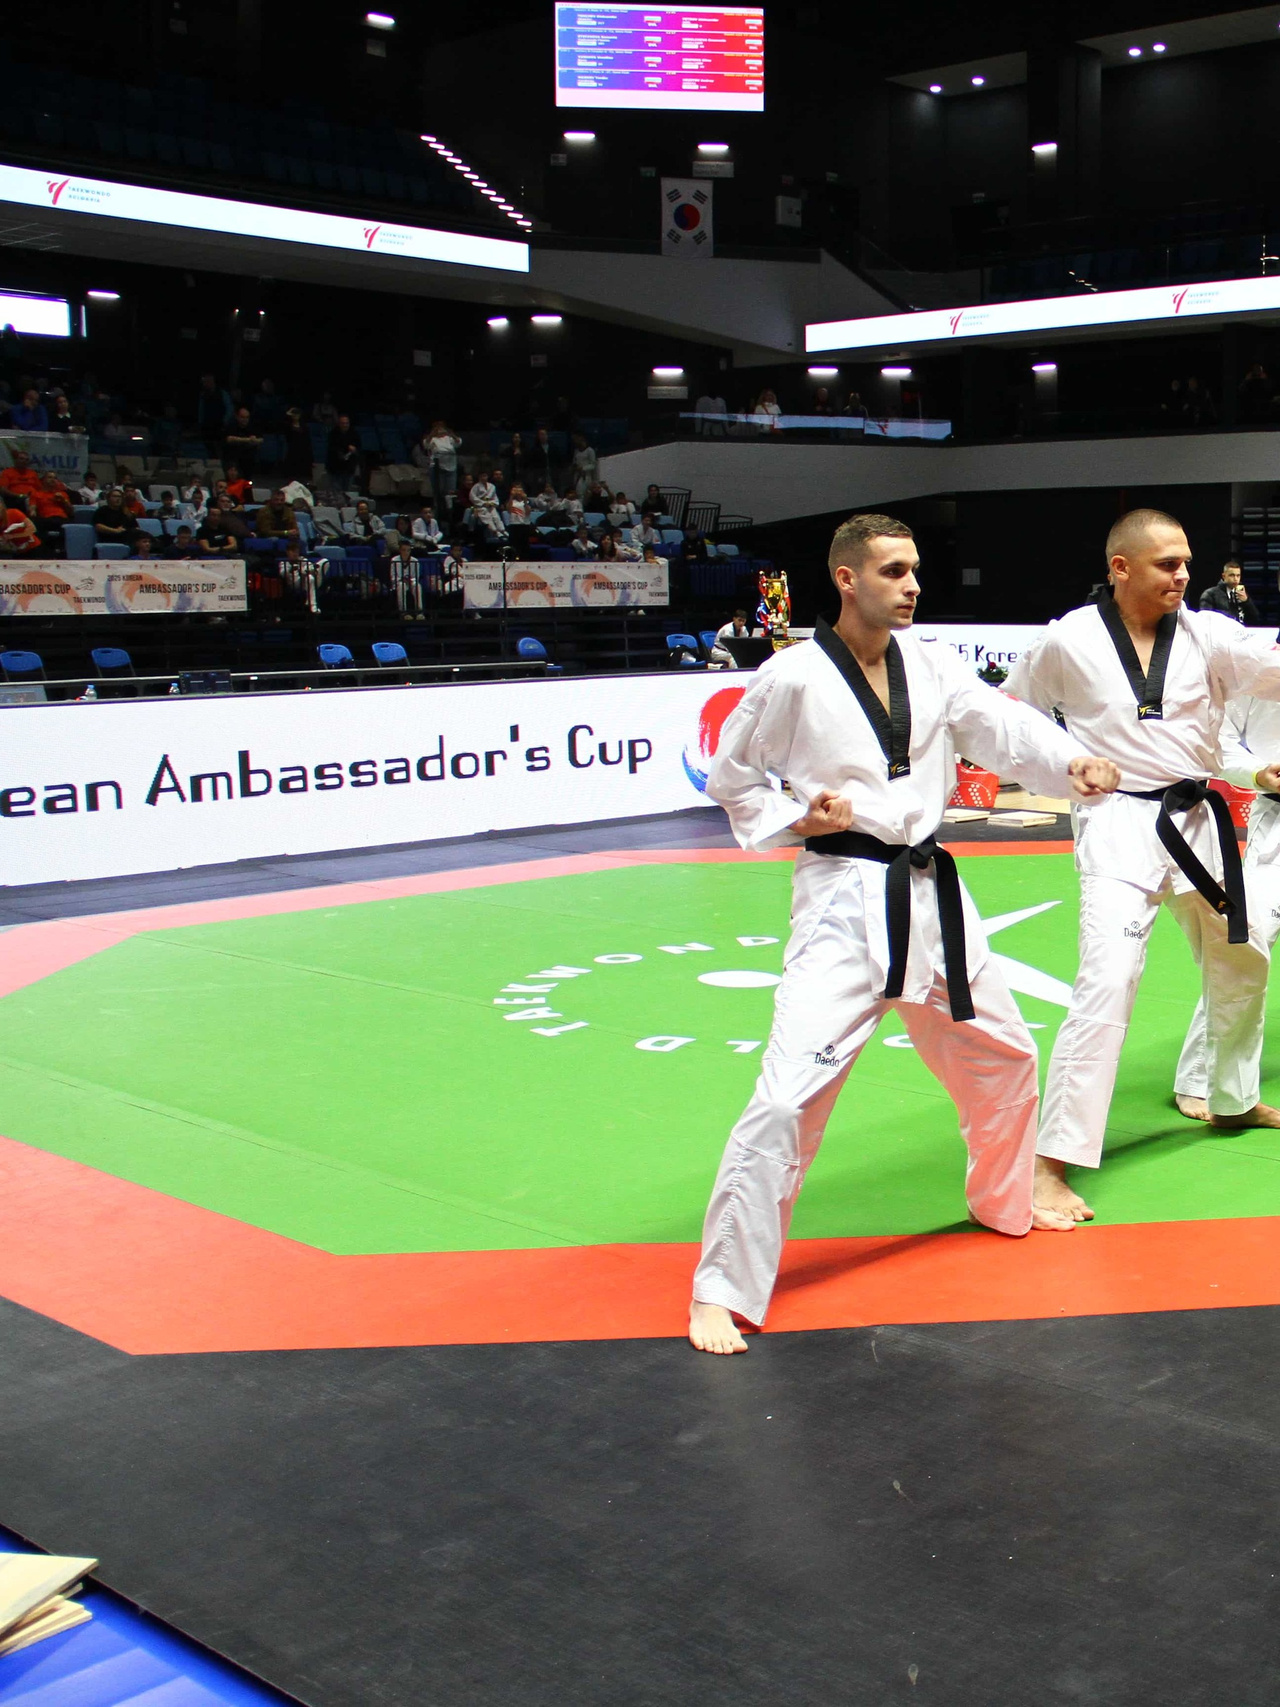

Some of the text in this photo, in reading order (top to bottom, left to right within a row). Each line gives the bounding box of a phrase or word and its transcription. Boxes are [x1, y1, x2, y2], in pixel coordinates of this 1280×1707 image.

[54, 584, 71, 594] CUP
[140, 583, 217, 594] AMBASSADOR'S CUP
[488, 582, 547, 591] AMBSSADOR'S CUP
[593, 581, 648, 590] AMBASSADOR'S CUP
[145, 724, 551, 806] Ambassador's
[567, 724, 653, 774] Cup
[815, 1052, 840, 1067] Daedo
